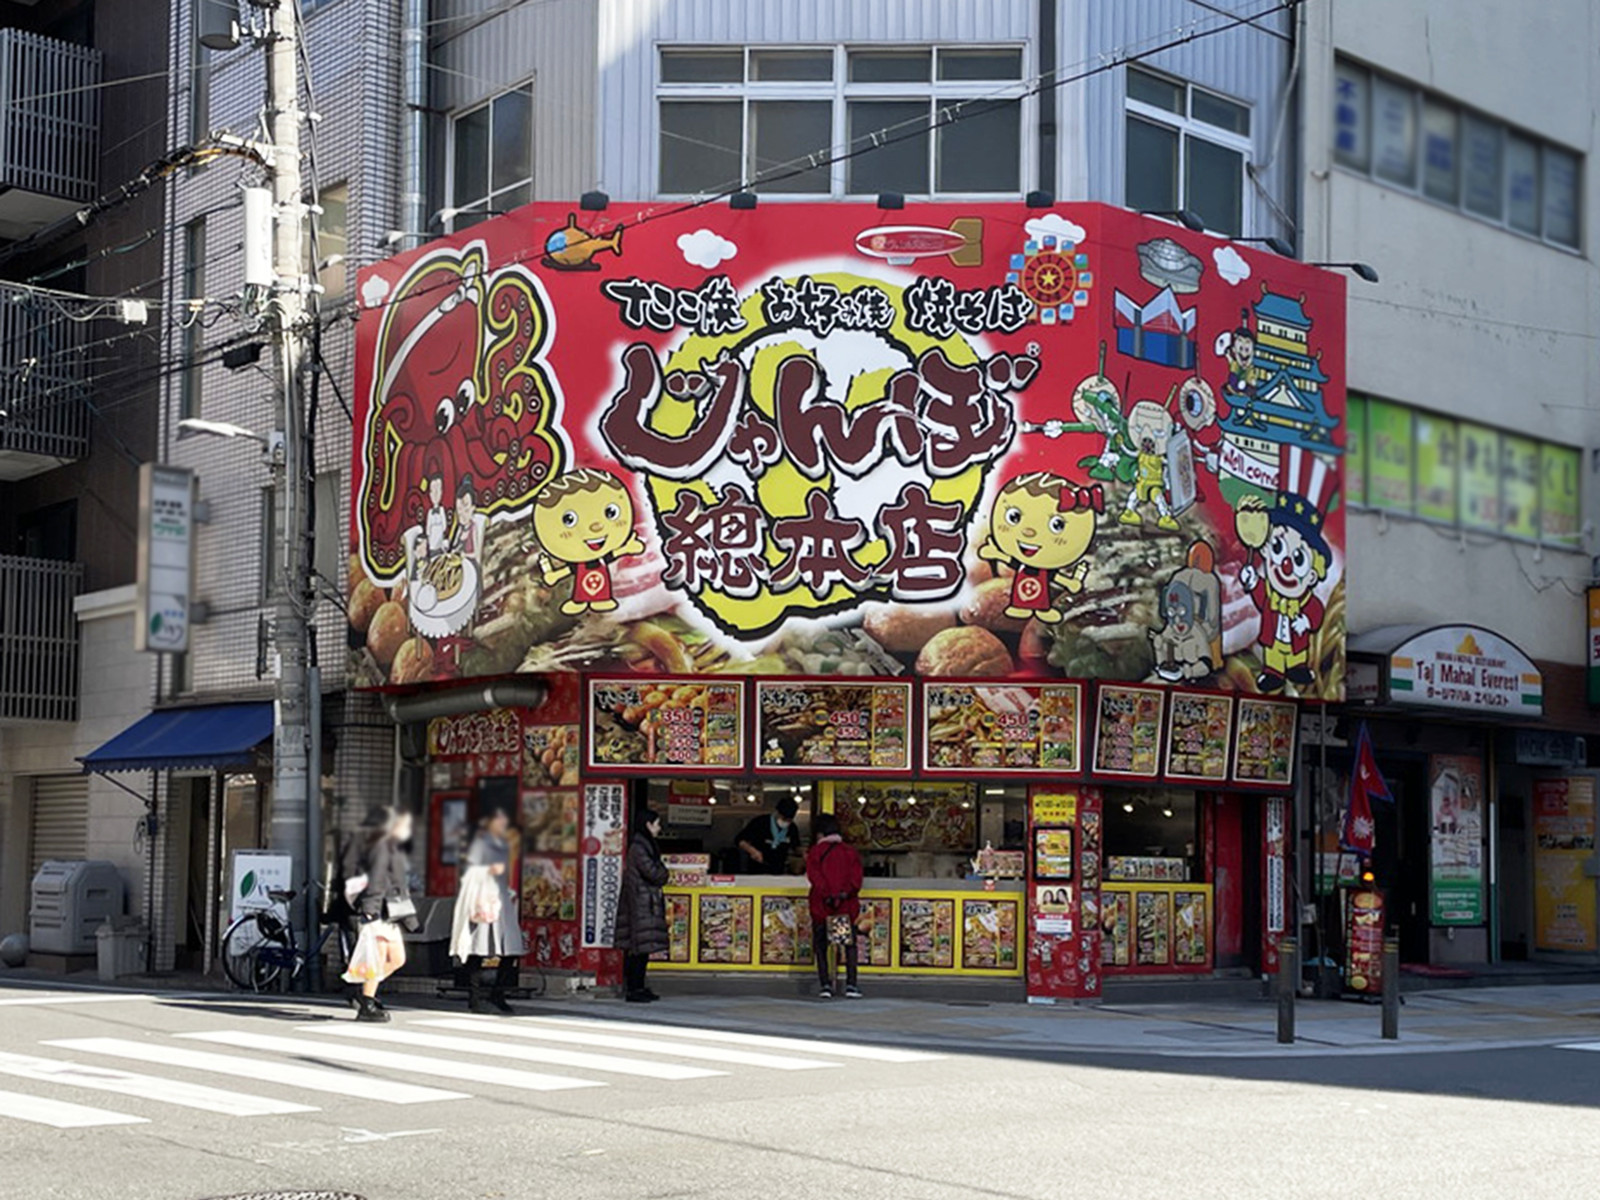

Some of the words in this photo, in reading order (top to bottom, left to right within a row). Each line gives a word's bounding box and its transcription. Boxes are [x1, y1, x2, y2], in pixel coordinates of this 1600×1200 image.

[604, 277, 747, 333] たこ焼
[763, 276, 894, 336] お好み焼
[906, 279, 1034, 338] 焼そば
[601, 342, 1040, 480] じゃんぼ
[1416, 660, 1435, 684] Taj
[1440, 663, 1475, 686] Mahal
[1481, 669, 1519, 691] Everest
[663, 709, 693, 723] 350
[829, 711, 860, 725] 450
[998, 713, 1028, 726] 450
